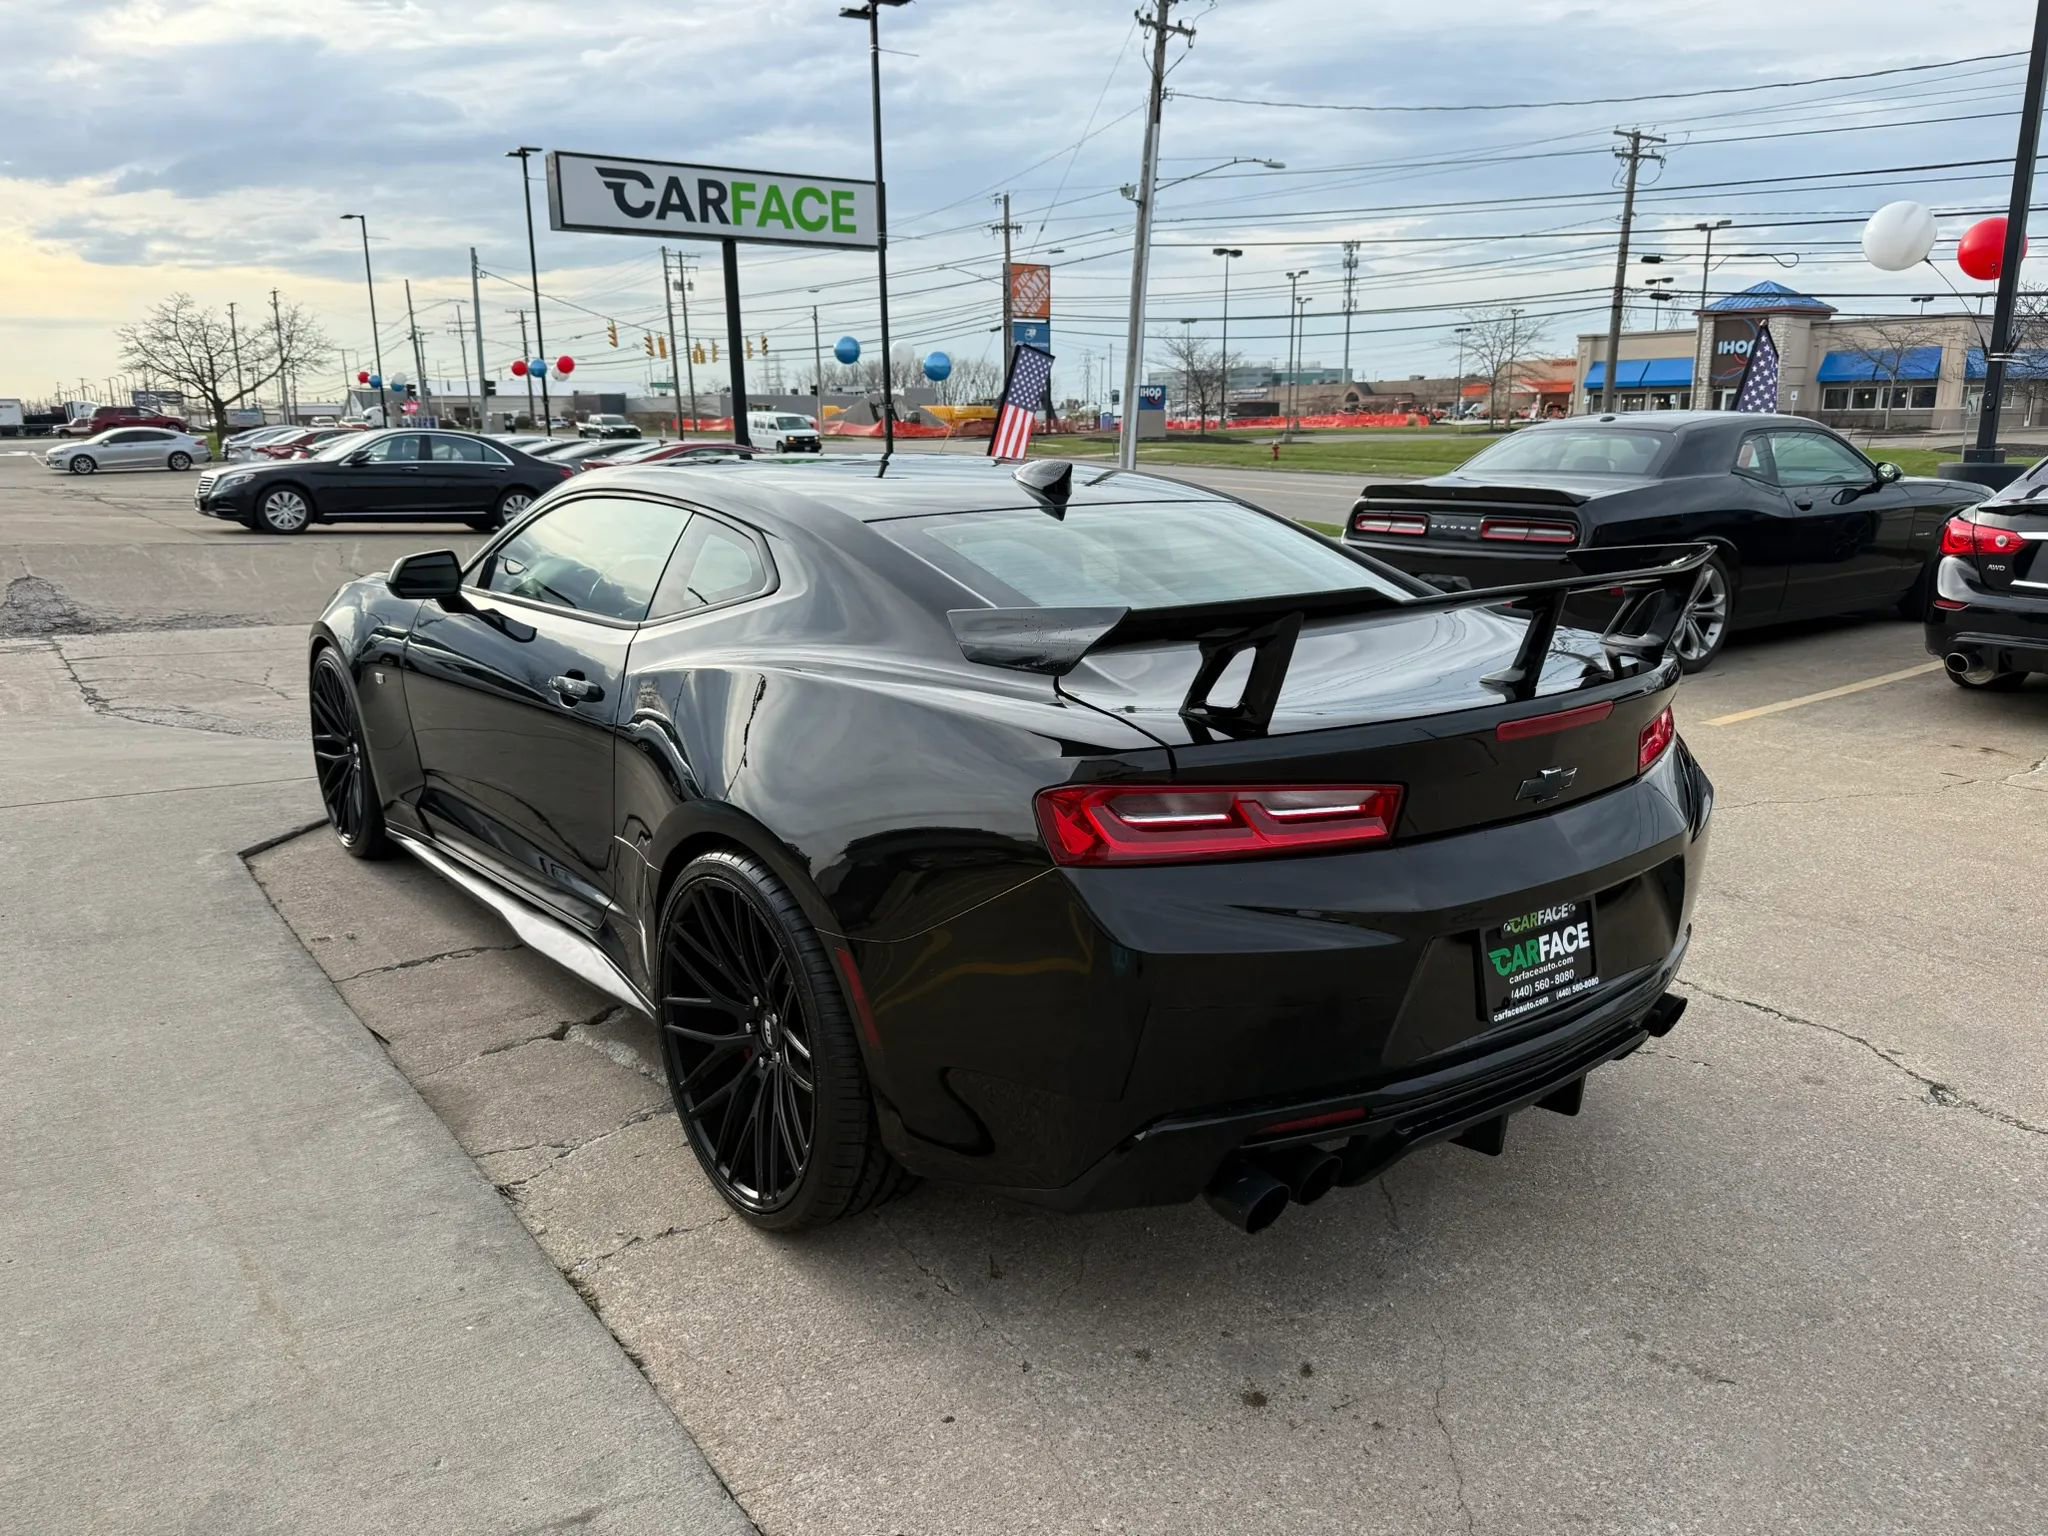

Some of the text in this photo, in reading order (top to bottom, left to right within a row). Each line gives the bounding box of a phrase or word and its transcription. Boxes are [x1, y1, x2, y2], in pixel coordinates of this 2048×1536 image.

[595, 166, 857, 234] CARFACE
[1508, 903, 1569, 933] CARFACE
[1488, 921, 1591, 976] CARFACE
[1509, 956, 1574, 984] carfaceauto.com
[1511, 984, 1533, 999] (440)
[1493, 996, 1549, 1022] carfaceauto.com
